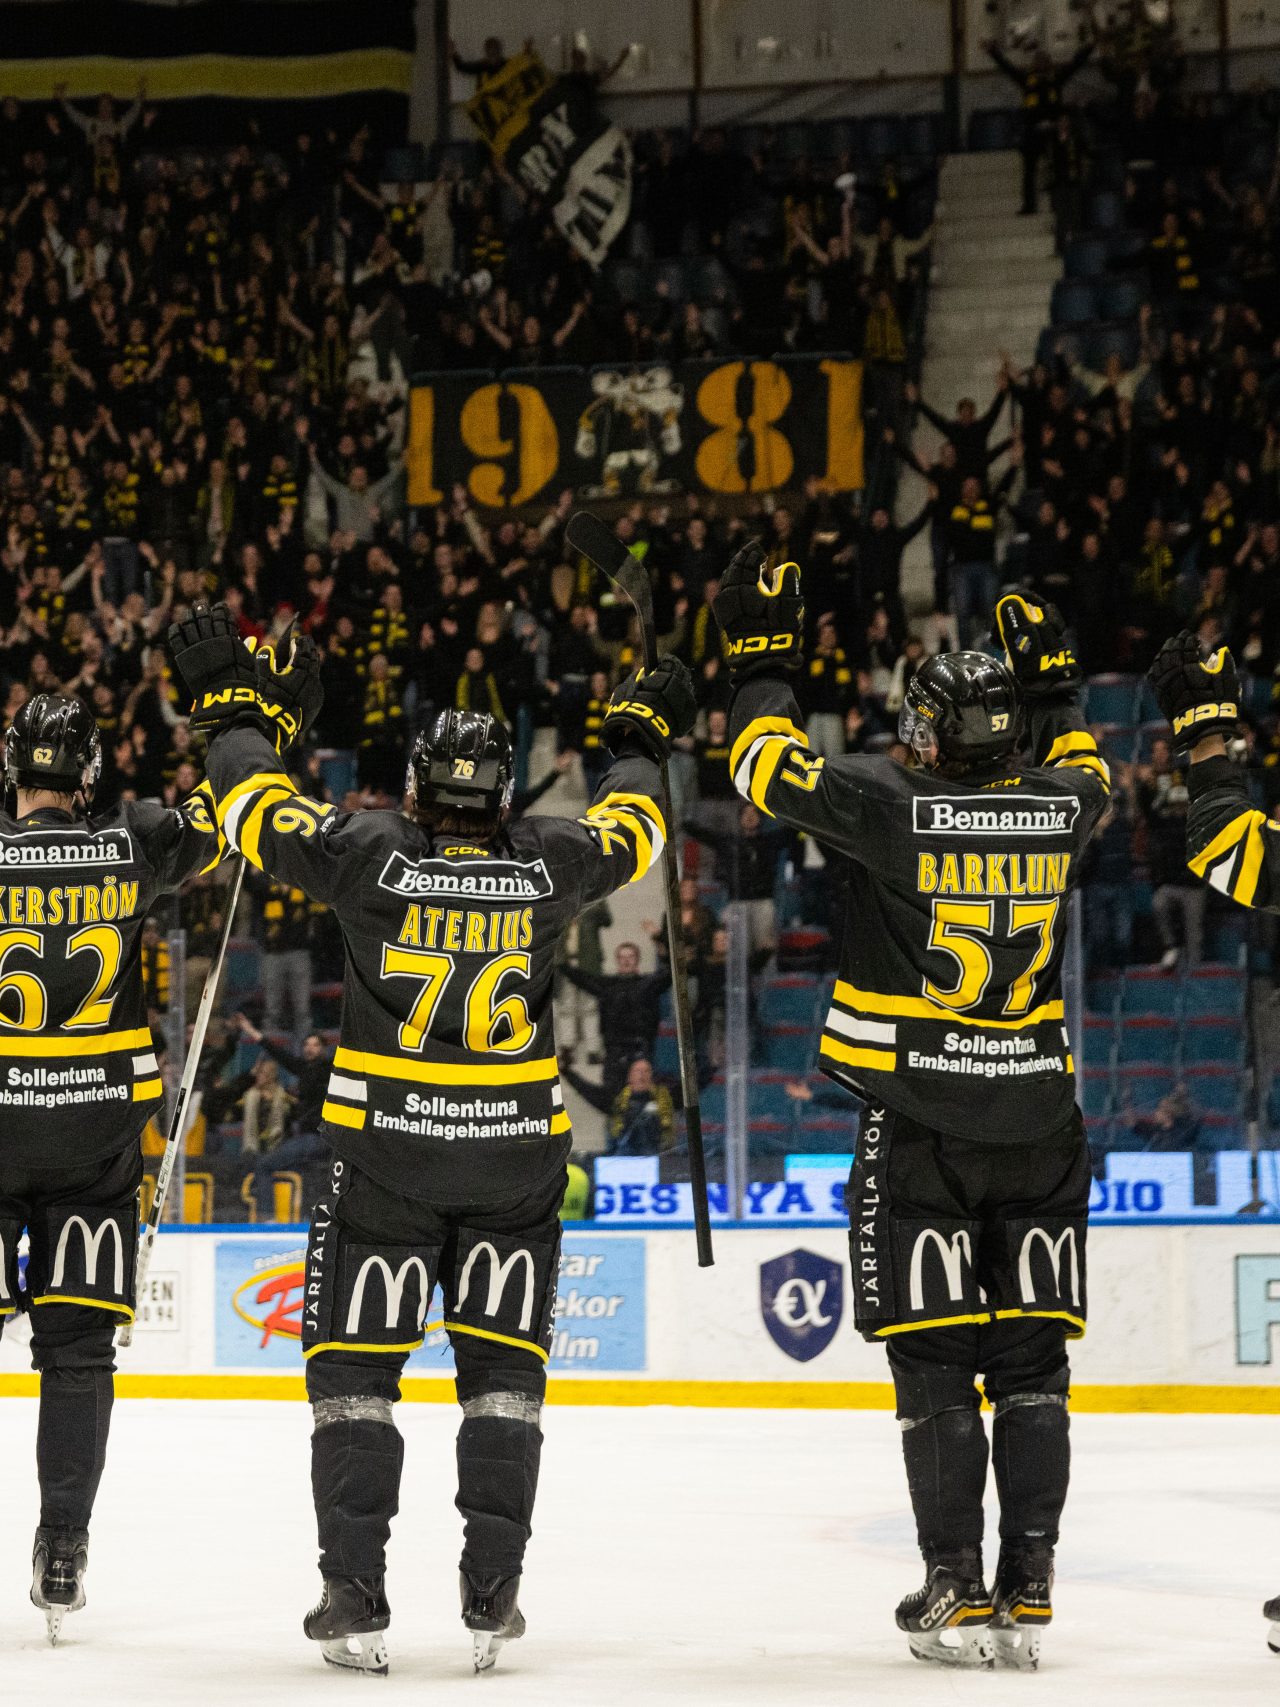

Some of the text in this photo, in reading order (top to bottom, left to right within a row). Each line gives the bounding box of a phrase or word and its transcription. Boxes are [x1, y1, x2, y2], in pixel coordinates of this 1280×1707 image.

[728, 632, 794, 656] CCM
[604, 701, 670, 737] CCM
[990, 713, 1010, 733] 57
[1173, 702, 1238, 735] CCM
[32, 747, 54, 765] 62
[454, 758, 475, 777] 76
[930, 802, 1067, 831] Bemannia
[444, 846, 489, 857] CCM
[394, 866, 540, 897] Bemannia
[397, 903, 534, 952] ATERIUS
[921, 895, 1060, 1015] 57
[379, 941, 538, 1056] 76
[7, 1066, 106, 1087] Sollentuna
[404, 1092, 519, 1119] Sollentuna
[372, 1109, 550, 1141] Emballagehantering
[331, 1160, 344, 1195] KÖ
[859, 1107, 886, 1308] JÄRFÄLLA KÖK
[919, 1587, 956, 1630] CCM
